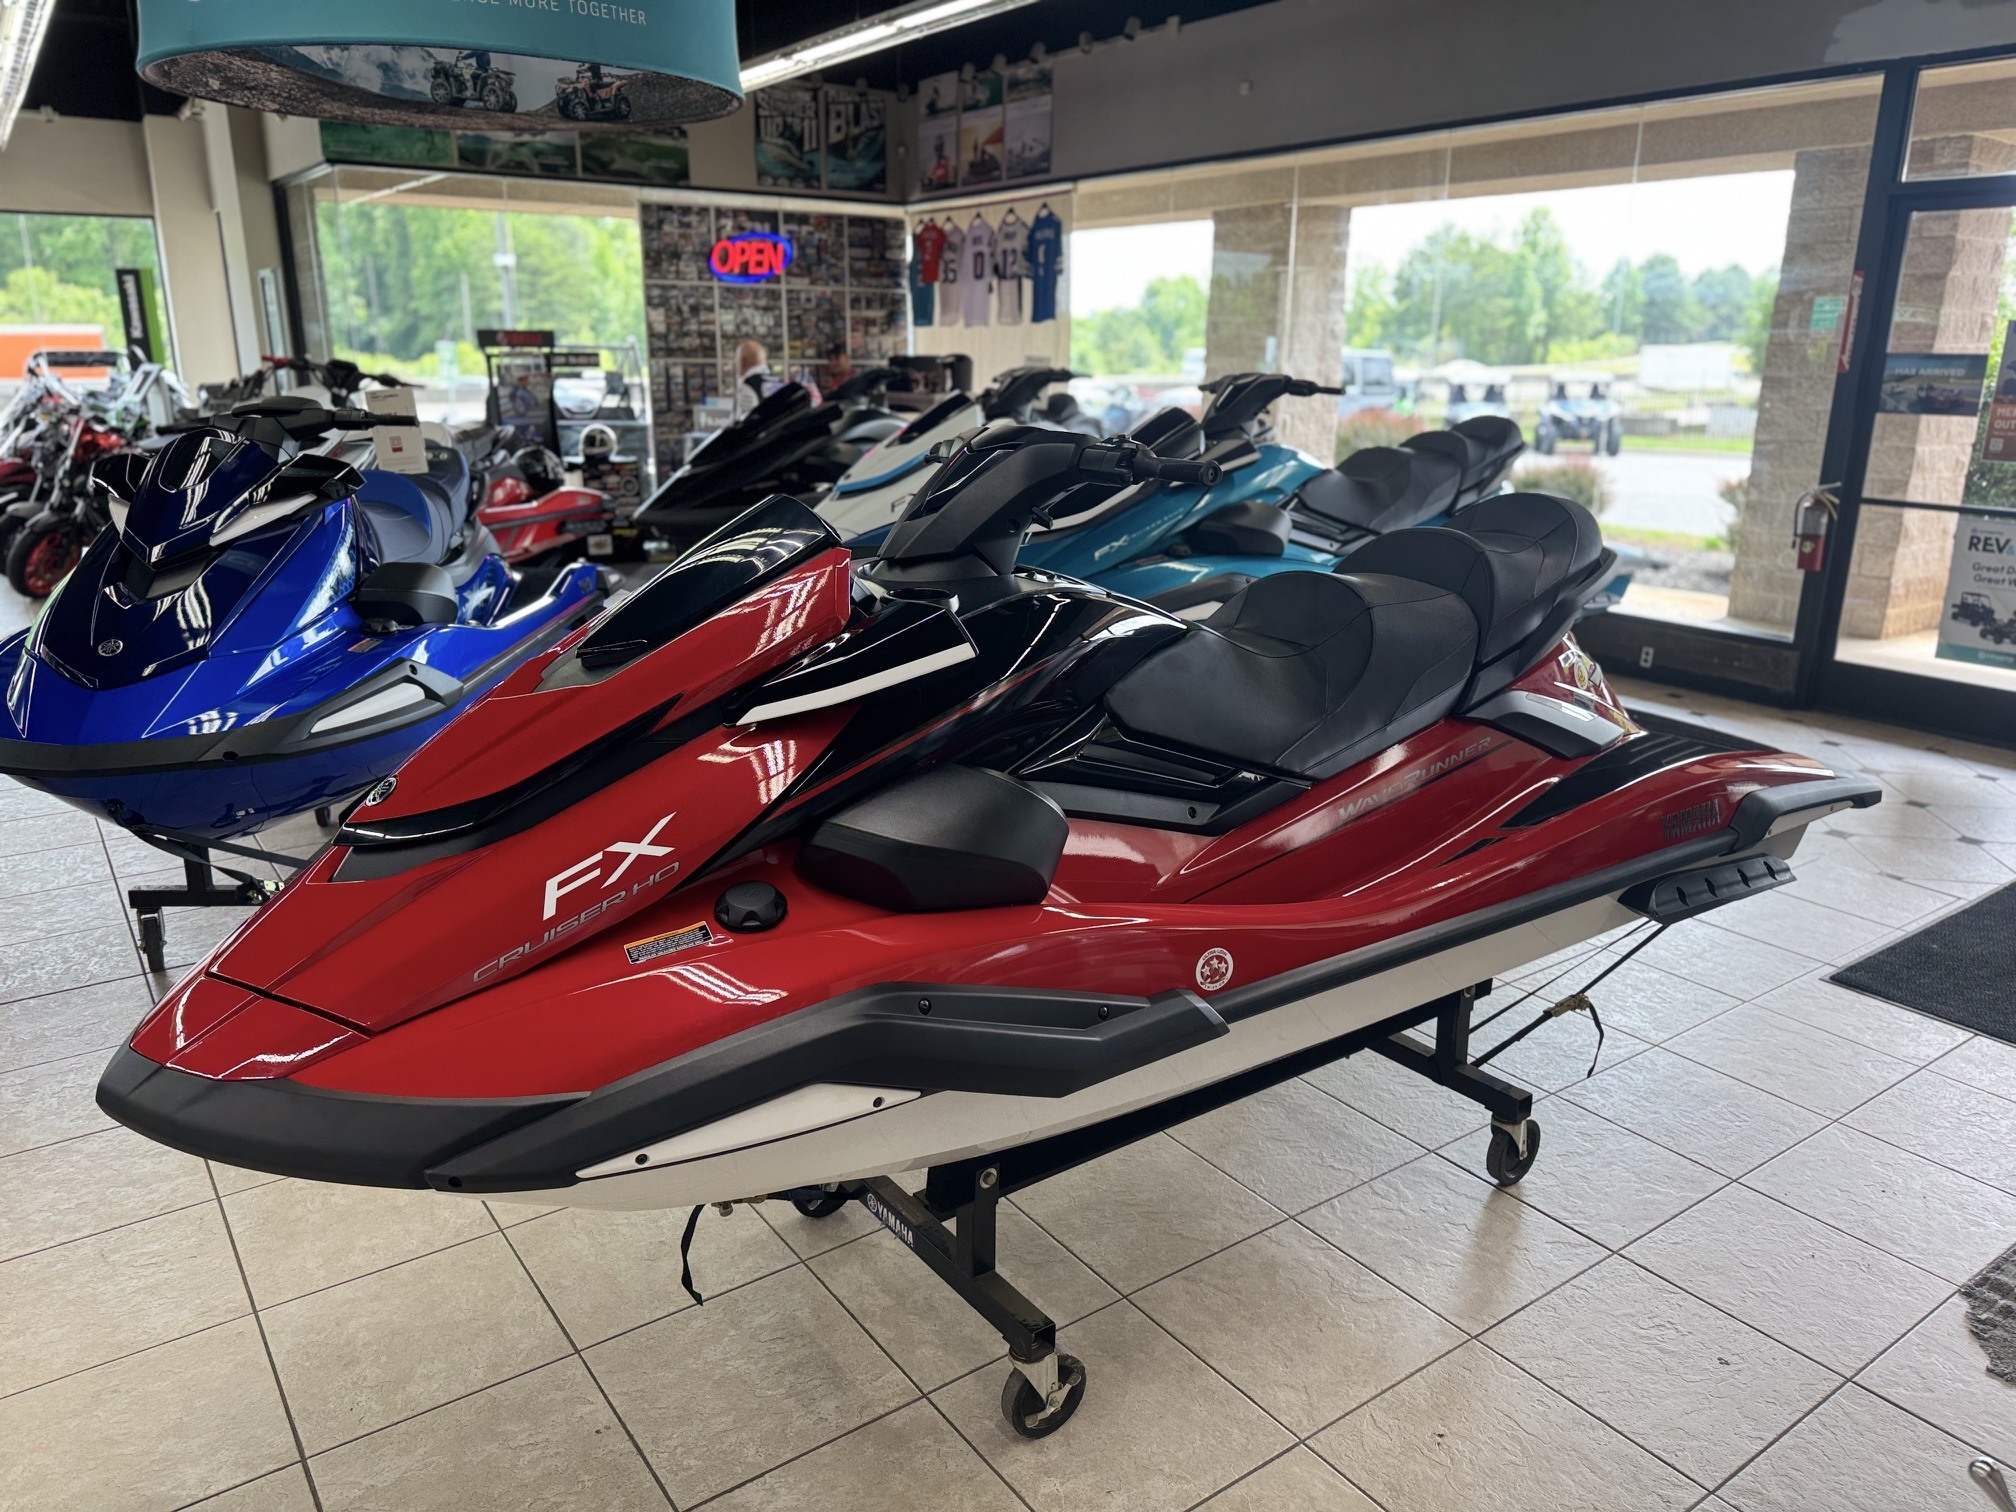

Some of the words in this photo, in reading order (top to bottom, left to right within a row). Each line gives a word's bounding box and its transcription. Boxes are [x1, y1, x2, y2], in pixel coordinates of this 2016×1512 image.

[569, 0, 647, 26] TOGETHER
[711, 239, 785, 275] OPEN
[1918, 367, 1966, 377] ARRIVED
[1094, 534, 1129, 561] FX
[1972, 561, 2005, 574] Great
[1973, 573, 2006, 585] Great
[1661, 798, 1720, 842] YAMAHA
[543, 812, 677, 921] FX
[473, 890, 627, 983] CRUISER
[632, 861, 680, 896] HO
[877, 1201, 914, 1248] YAMAHA
